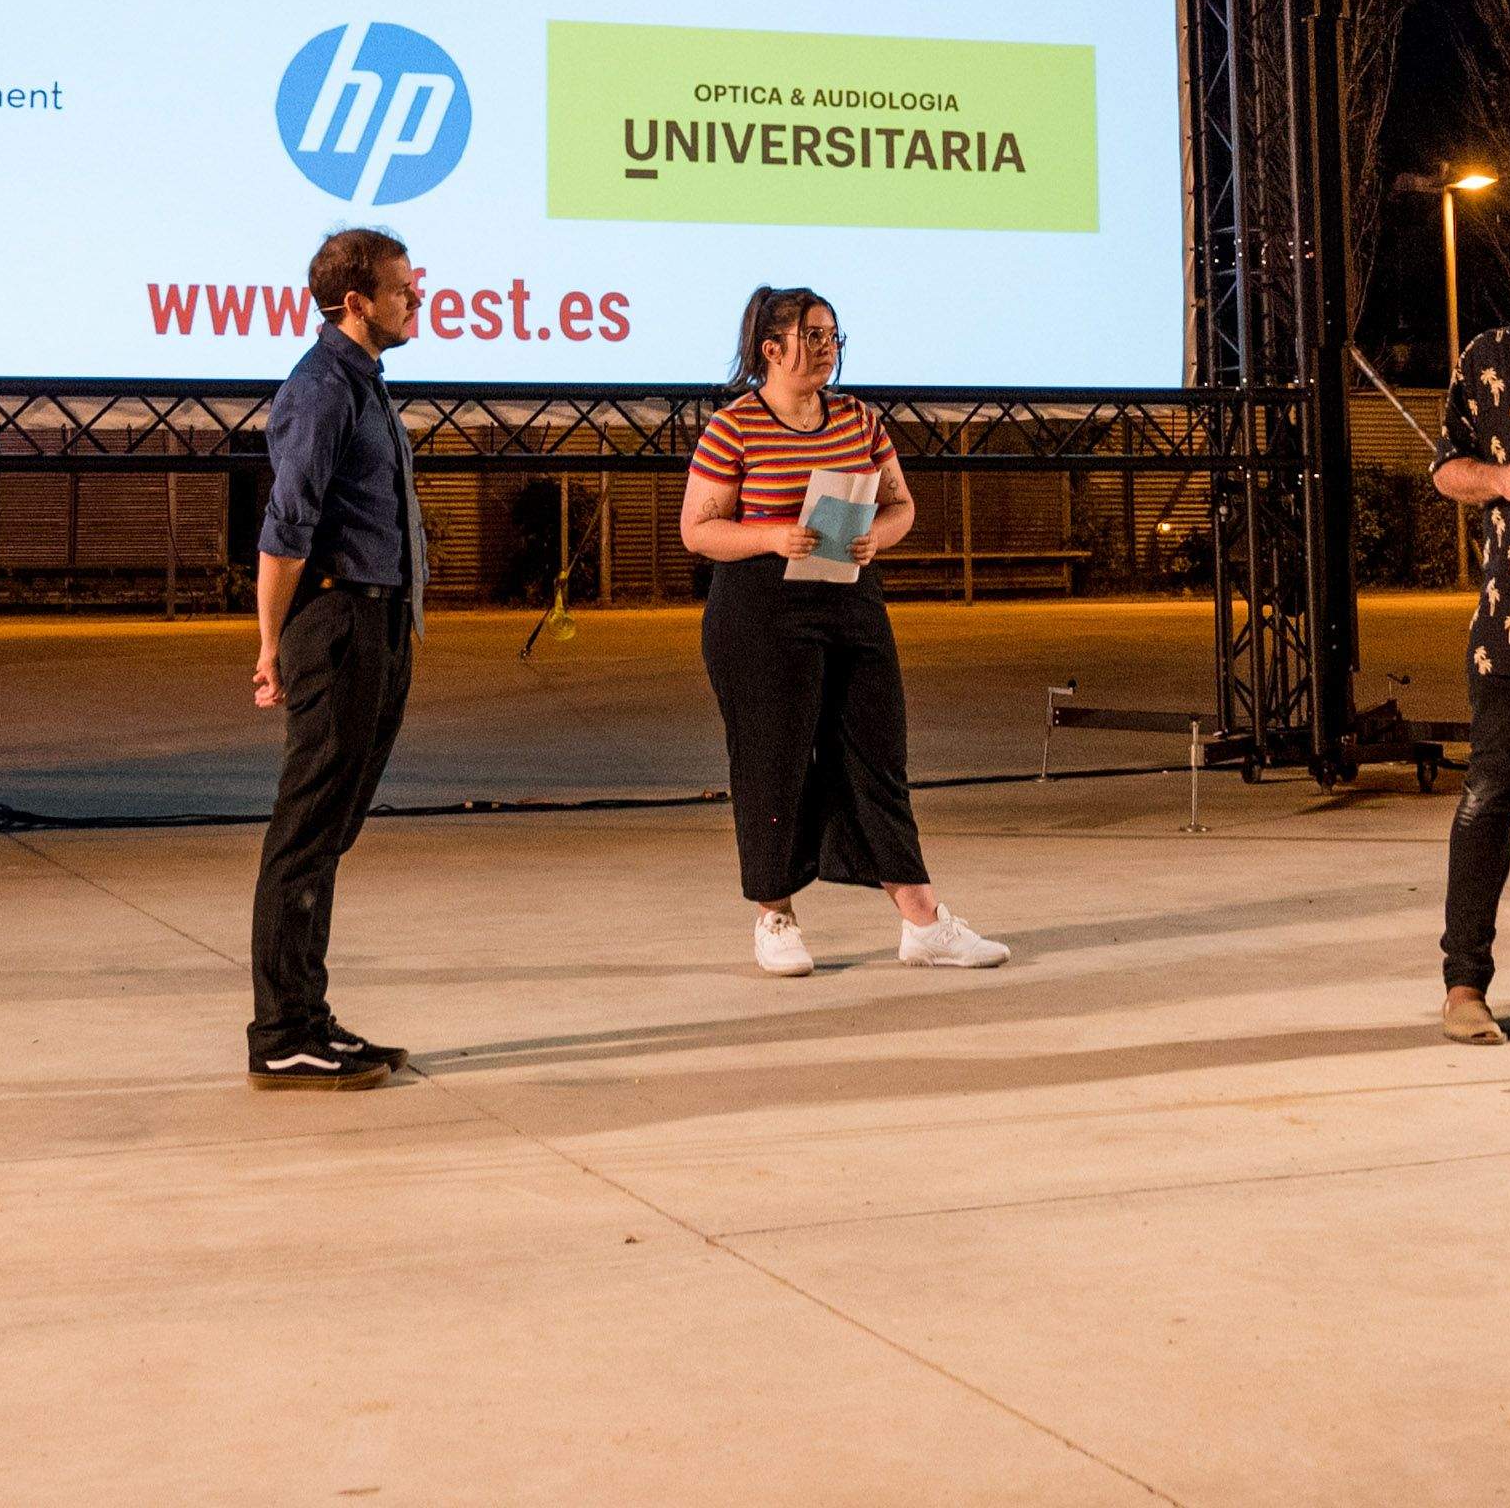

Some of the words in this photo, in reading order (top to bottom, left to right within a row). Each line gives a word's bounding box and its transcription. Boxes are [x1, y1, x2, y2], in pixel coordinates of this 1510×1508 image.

[297, 21, 455, 206] hp
[693, 83, 784, 106] OPTICA
[789, 87, 806, 107] &
[812, 88, 960, 113] AUDIOLOGIA
[624, 117, 1027, 180] UNIVERSITARIA
[146, 266, 631, 342] wwwfest.es
